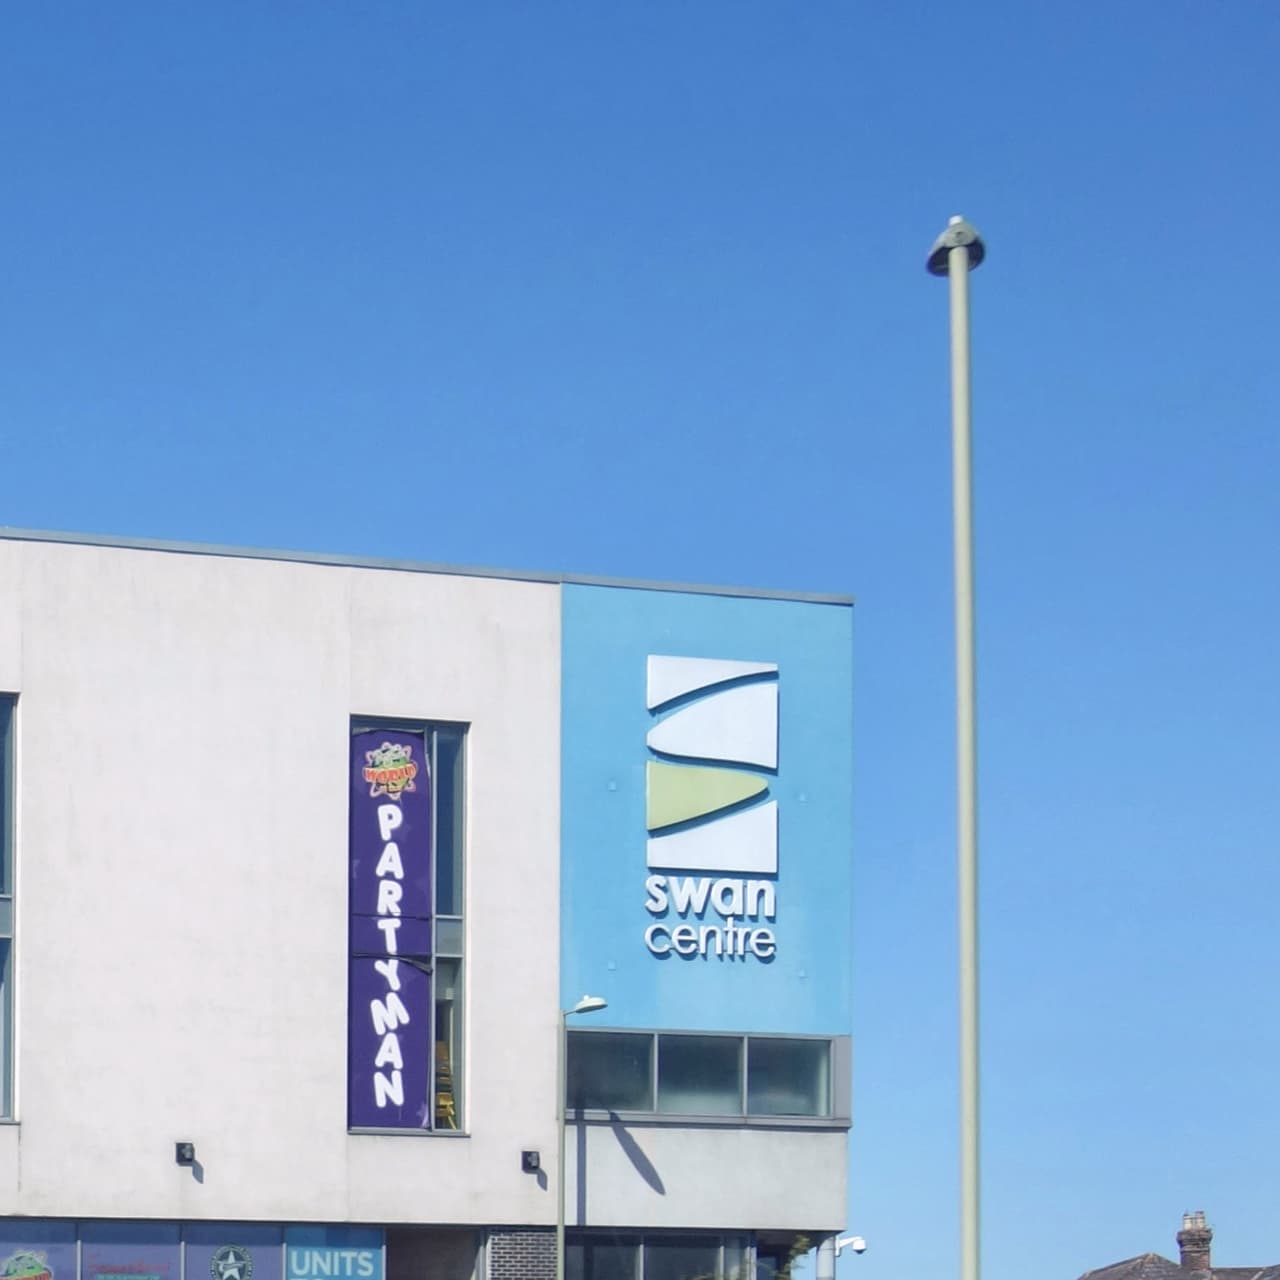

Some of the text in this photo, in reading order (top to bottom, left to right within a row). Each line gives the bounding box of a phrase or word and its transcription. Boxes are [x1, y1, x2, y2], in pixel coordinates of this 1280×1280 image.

[645, 876, 776, 916] swan
[370, 804, 410, 1108] PARTYMAN
[645, 916, 776, 957] centre
[291, 1250, 374, 1276] UNITS
